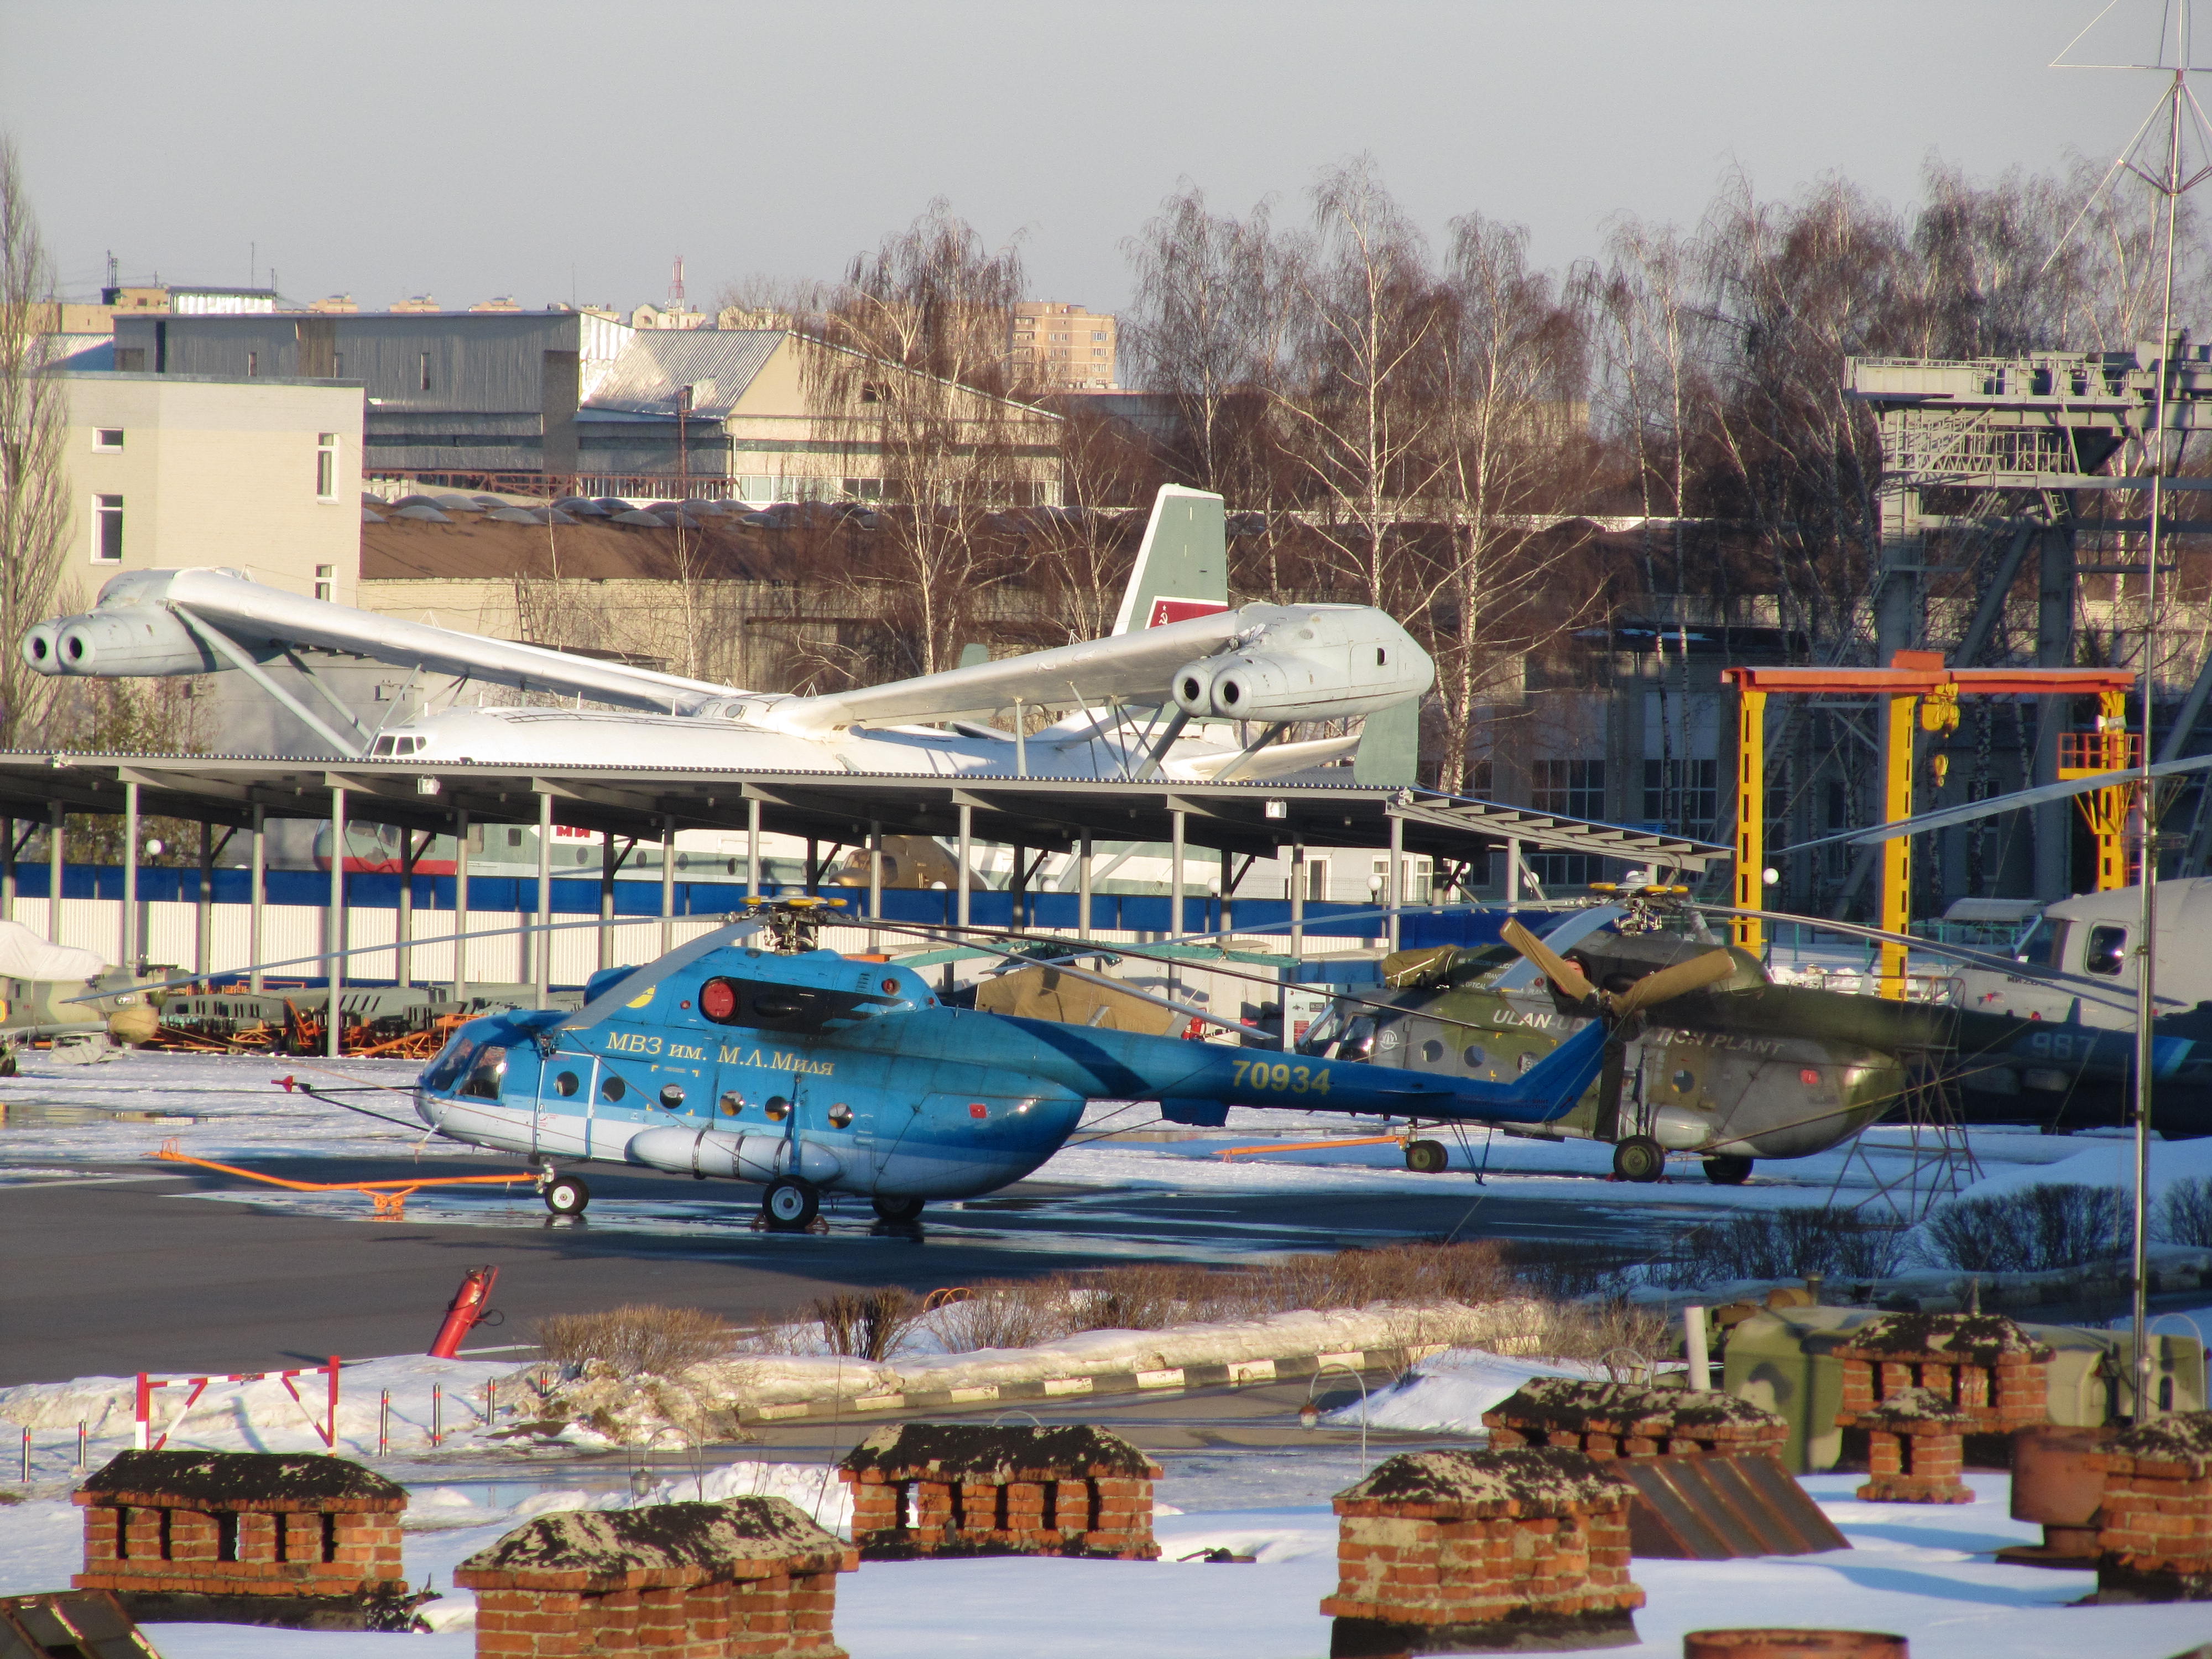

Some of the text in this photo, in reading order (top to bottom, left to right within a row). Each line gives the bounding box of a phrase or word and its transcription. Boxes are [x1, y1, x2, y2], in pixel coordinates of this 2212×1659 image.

[1465, 982, 1487, 990] OPTICAL
[1493, 1008, 1588, 1031] ULAN-UD
[606, 1031, 664, 1055] МВЗ
[667, 1044, 708, 1061] им.
[1648, 1026, 1786, 1056] TION PLANT
[2032, 1031, 2098, 1062] 987
[1232, 1060, 1332, 1096] 70934
